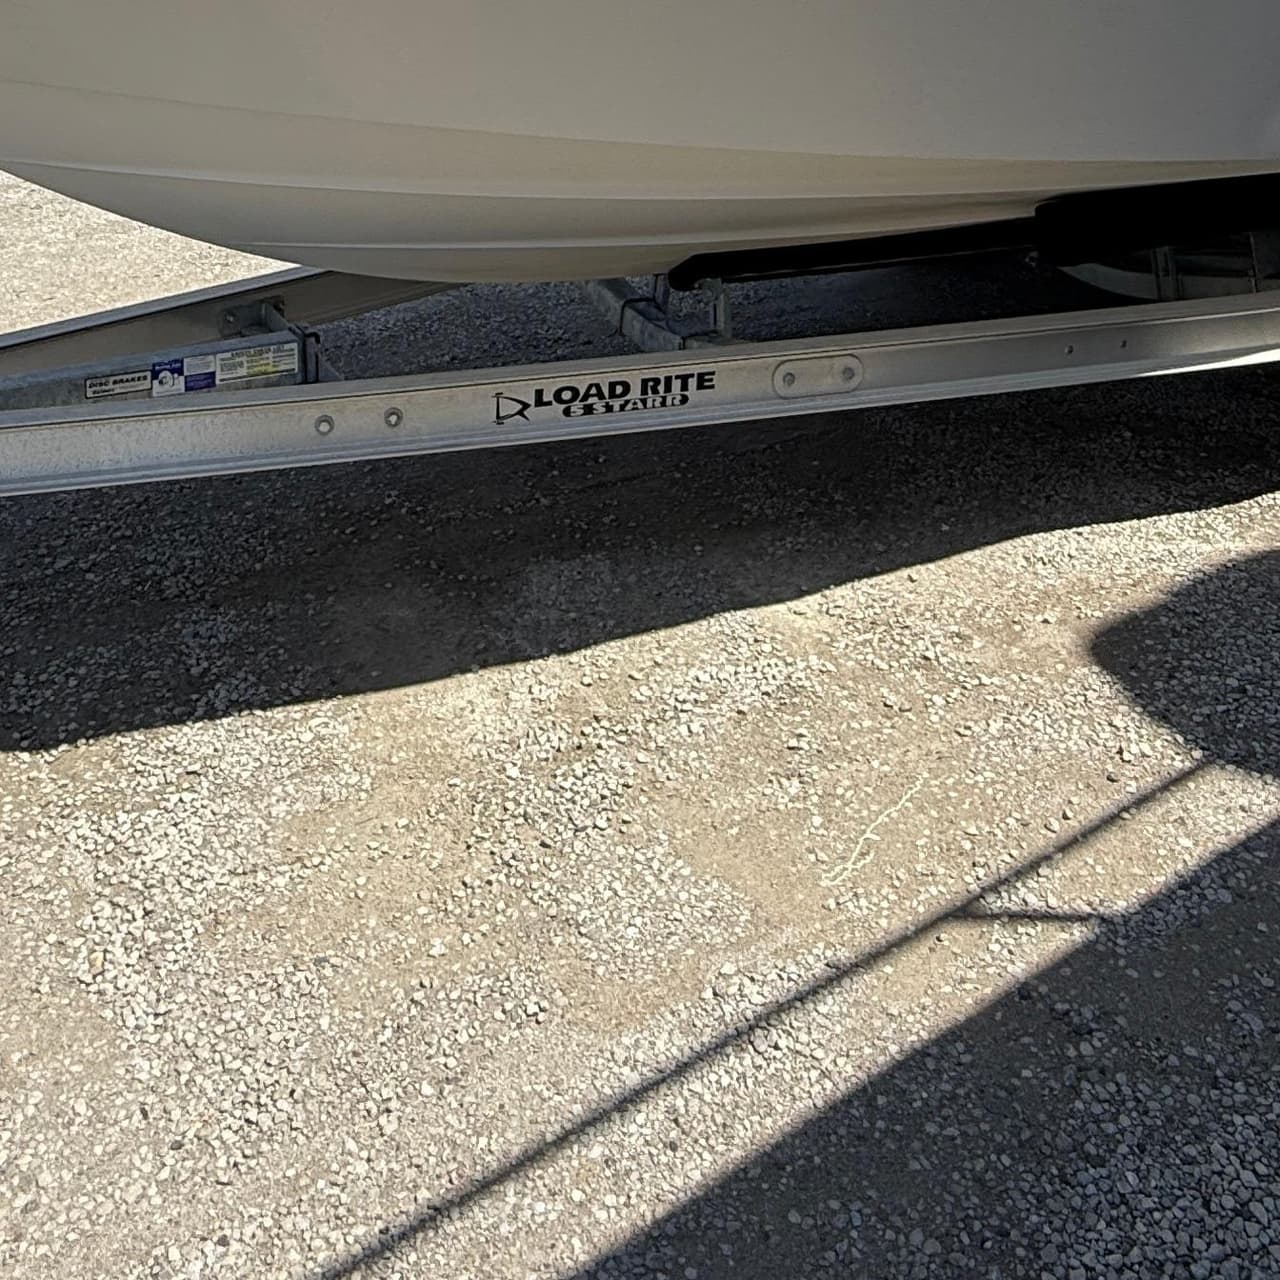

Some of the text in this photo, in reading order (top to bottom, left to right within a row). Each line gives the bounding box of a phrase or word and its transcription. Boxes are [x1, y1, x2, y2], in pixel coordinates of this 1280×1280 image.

[534, 371, 716, 408] LOAD RITE
[593, 393, 683, 414] STARR
